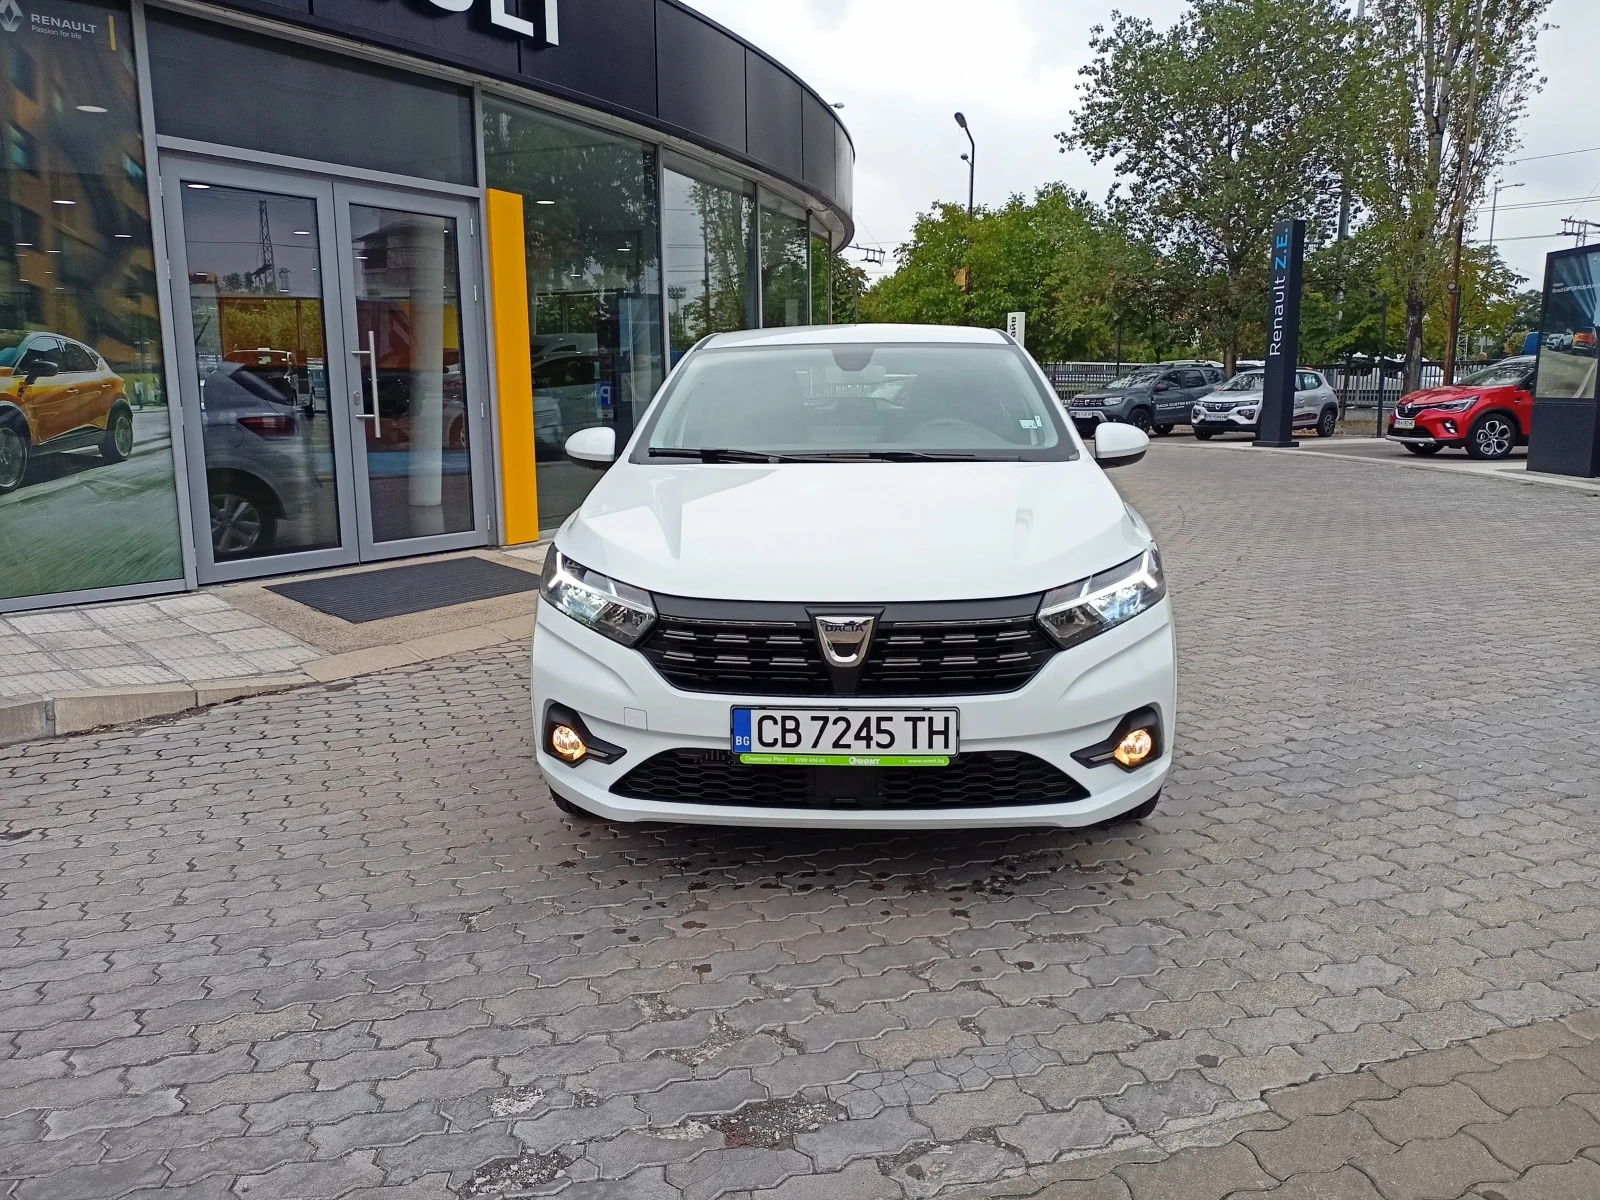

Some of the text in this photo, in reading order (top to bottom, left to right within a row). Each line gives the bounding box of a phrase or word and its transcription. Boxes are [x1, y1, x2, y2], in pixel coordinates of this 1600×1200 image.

[30, 13, 97, 34] RENAULT
[31, 25, 82, 39] Passion for life
[1269, 228, 1288, 356] Renault Z.E.
[825, 624, 864, 632] DACIA
[757, 714, 950, 750] CB 7245 TH
[735, 736, 750, 746] BG
